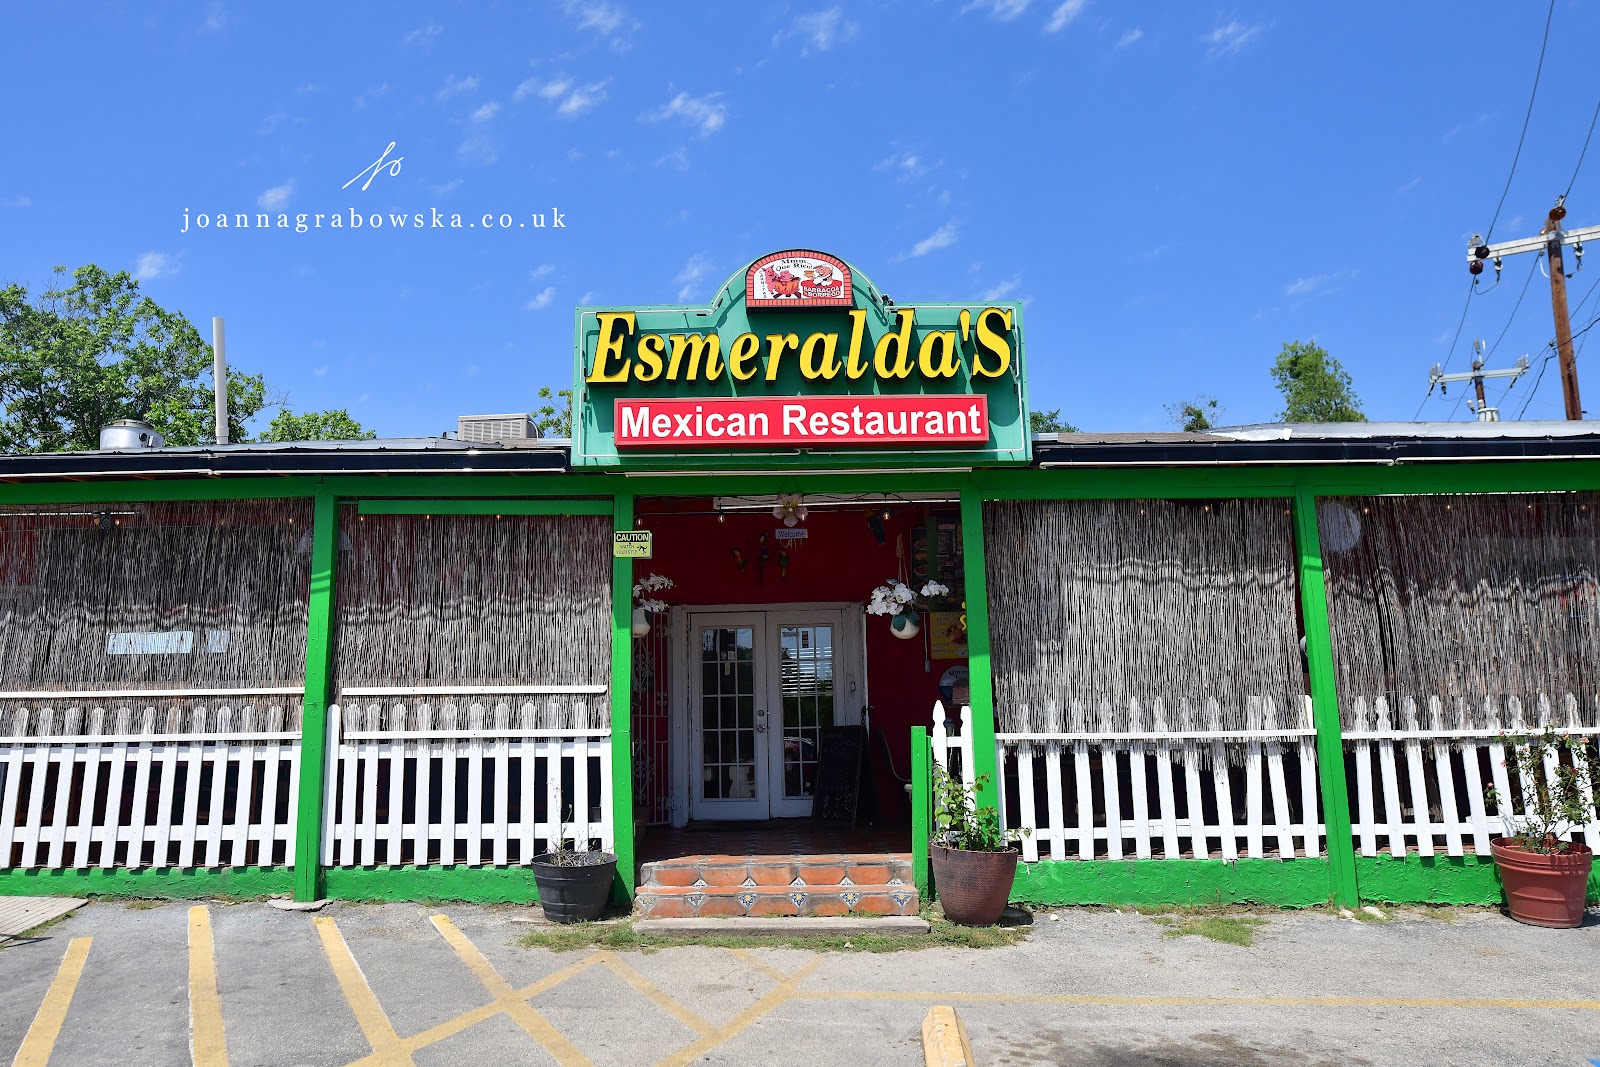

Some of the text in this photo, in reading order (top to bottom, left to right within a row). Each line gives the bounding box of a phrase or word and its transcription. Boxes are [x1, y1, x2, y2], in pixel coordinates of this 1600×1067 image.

[803, 286, 840, 294] BARBACOA
[586, 307, 1012, 383] Esmeralda'S
[621, 403, 982, 438] Mexican Restaurant
[616, 533, 649, 541] CAUTION
